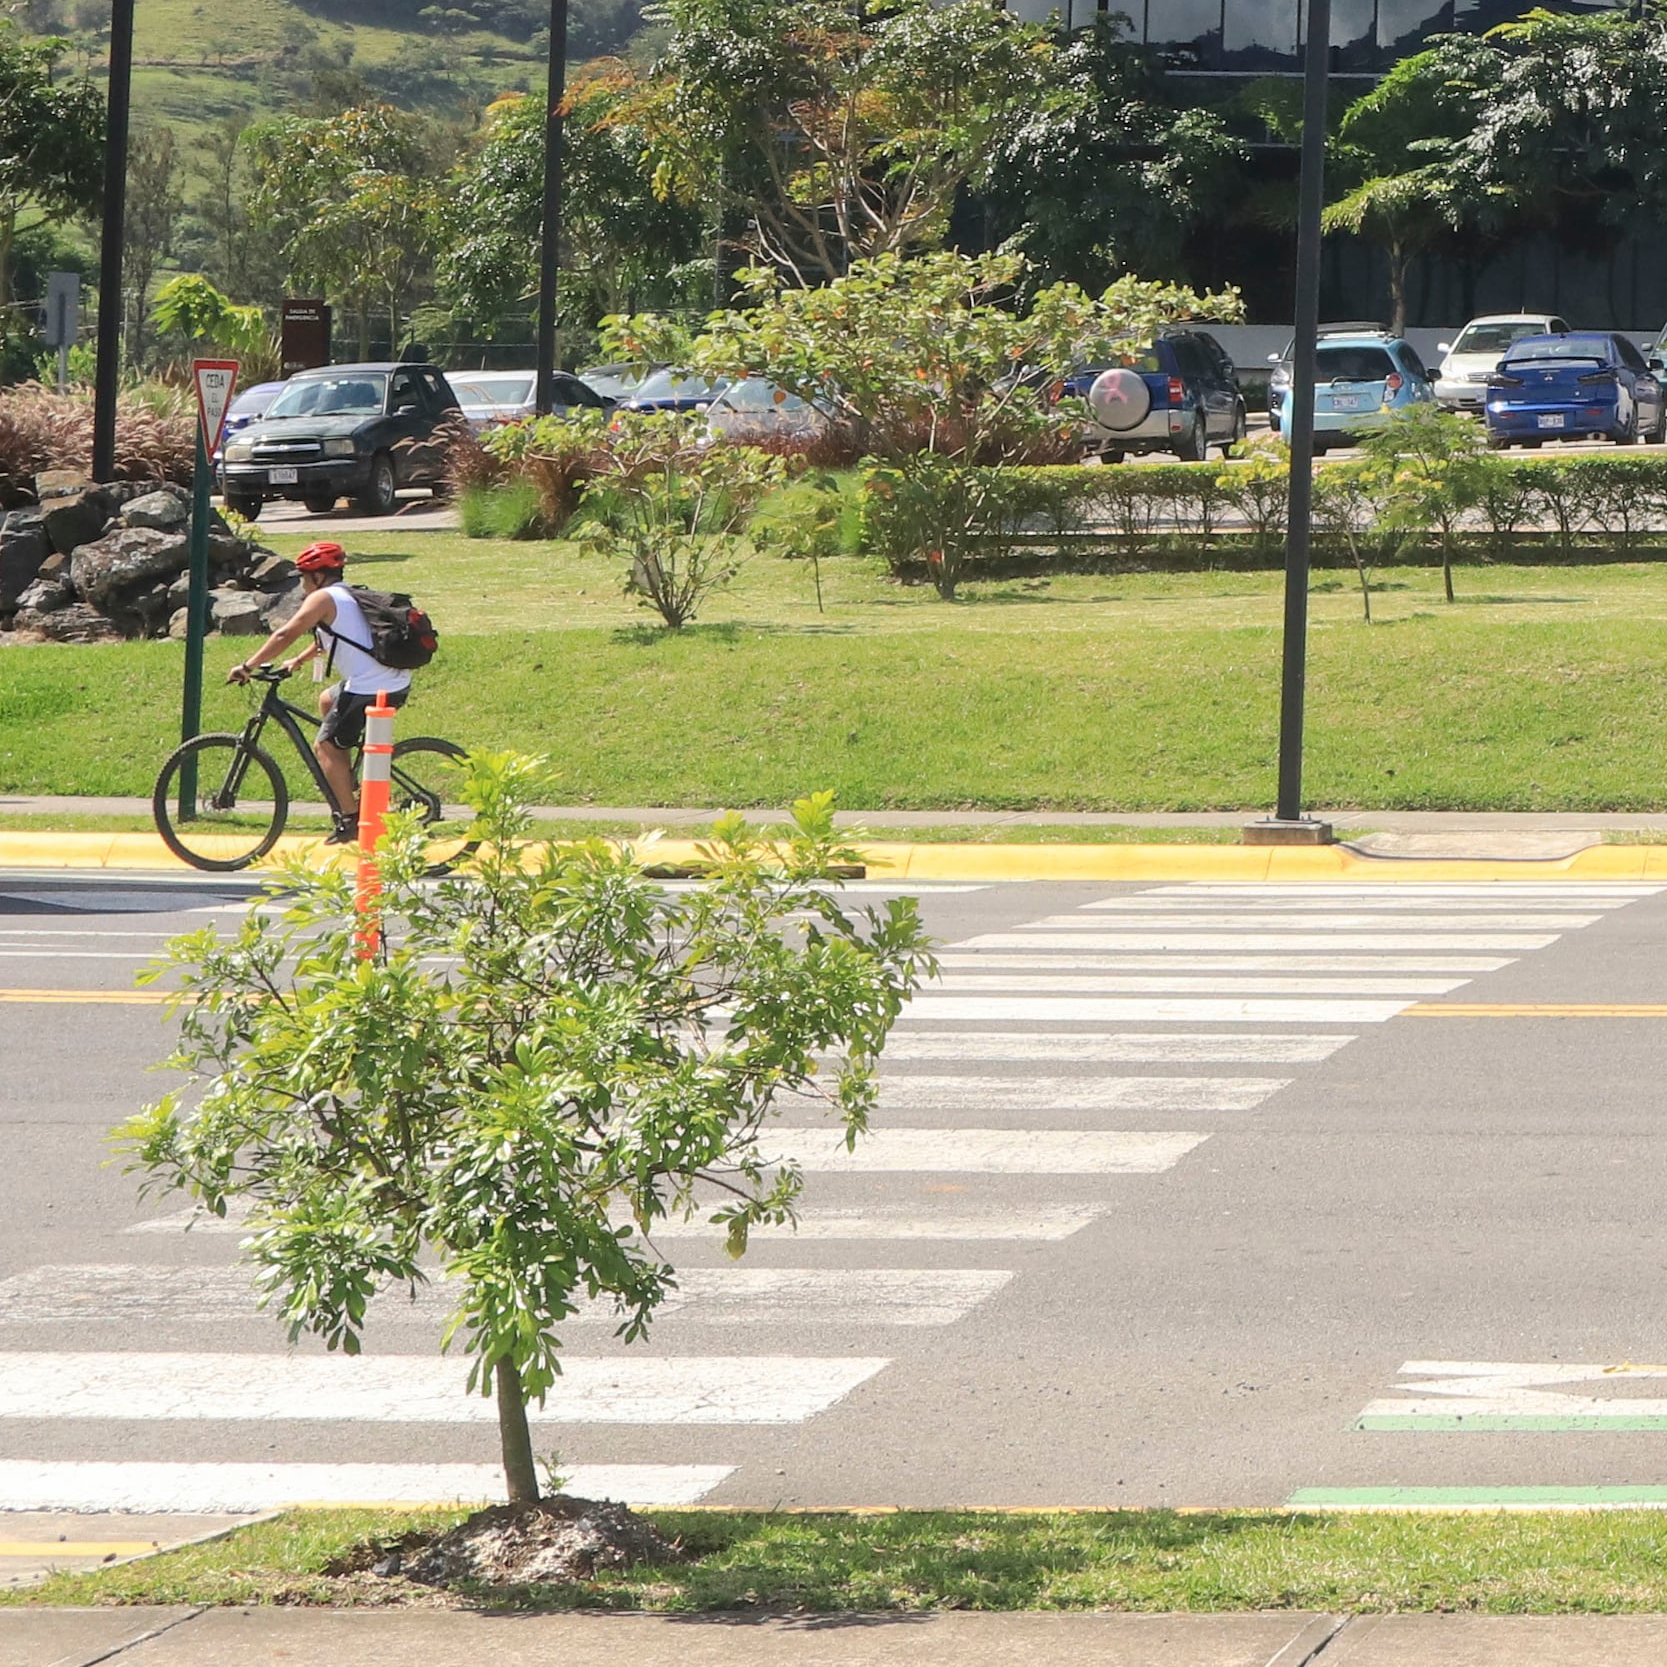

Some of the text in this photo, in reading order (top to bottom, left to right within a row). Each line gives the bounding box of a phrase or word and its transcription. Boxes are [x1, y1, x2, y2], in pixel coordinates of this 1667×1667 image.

[206, 374, 225, 389] CEDA
[211, 393, 218, 404] EL
[207, 407, 222, 417] PASO
